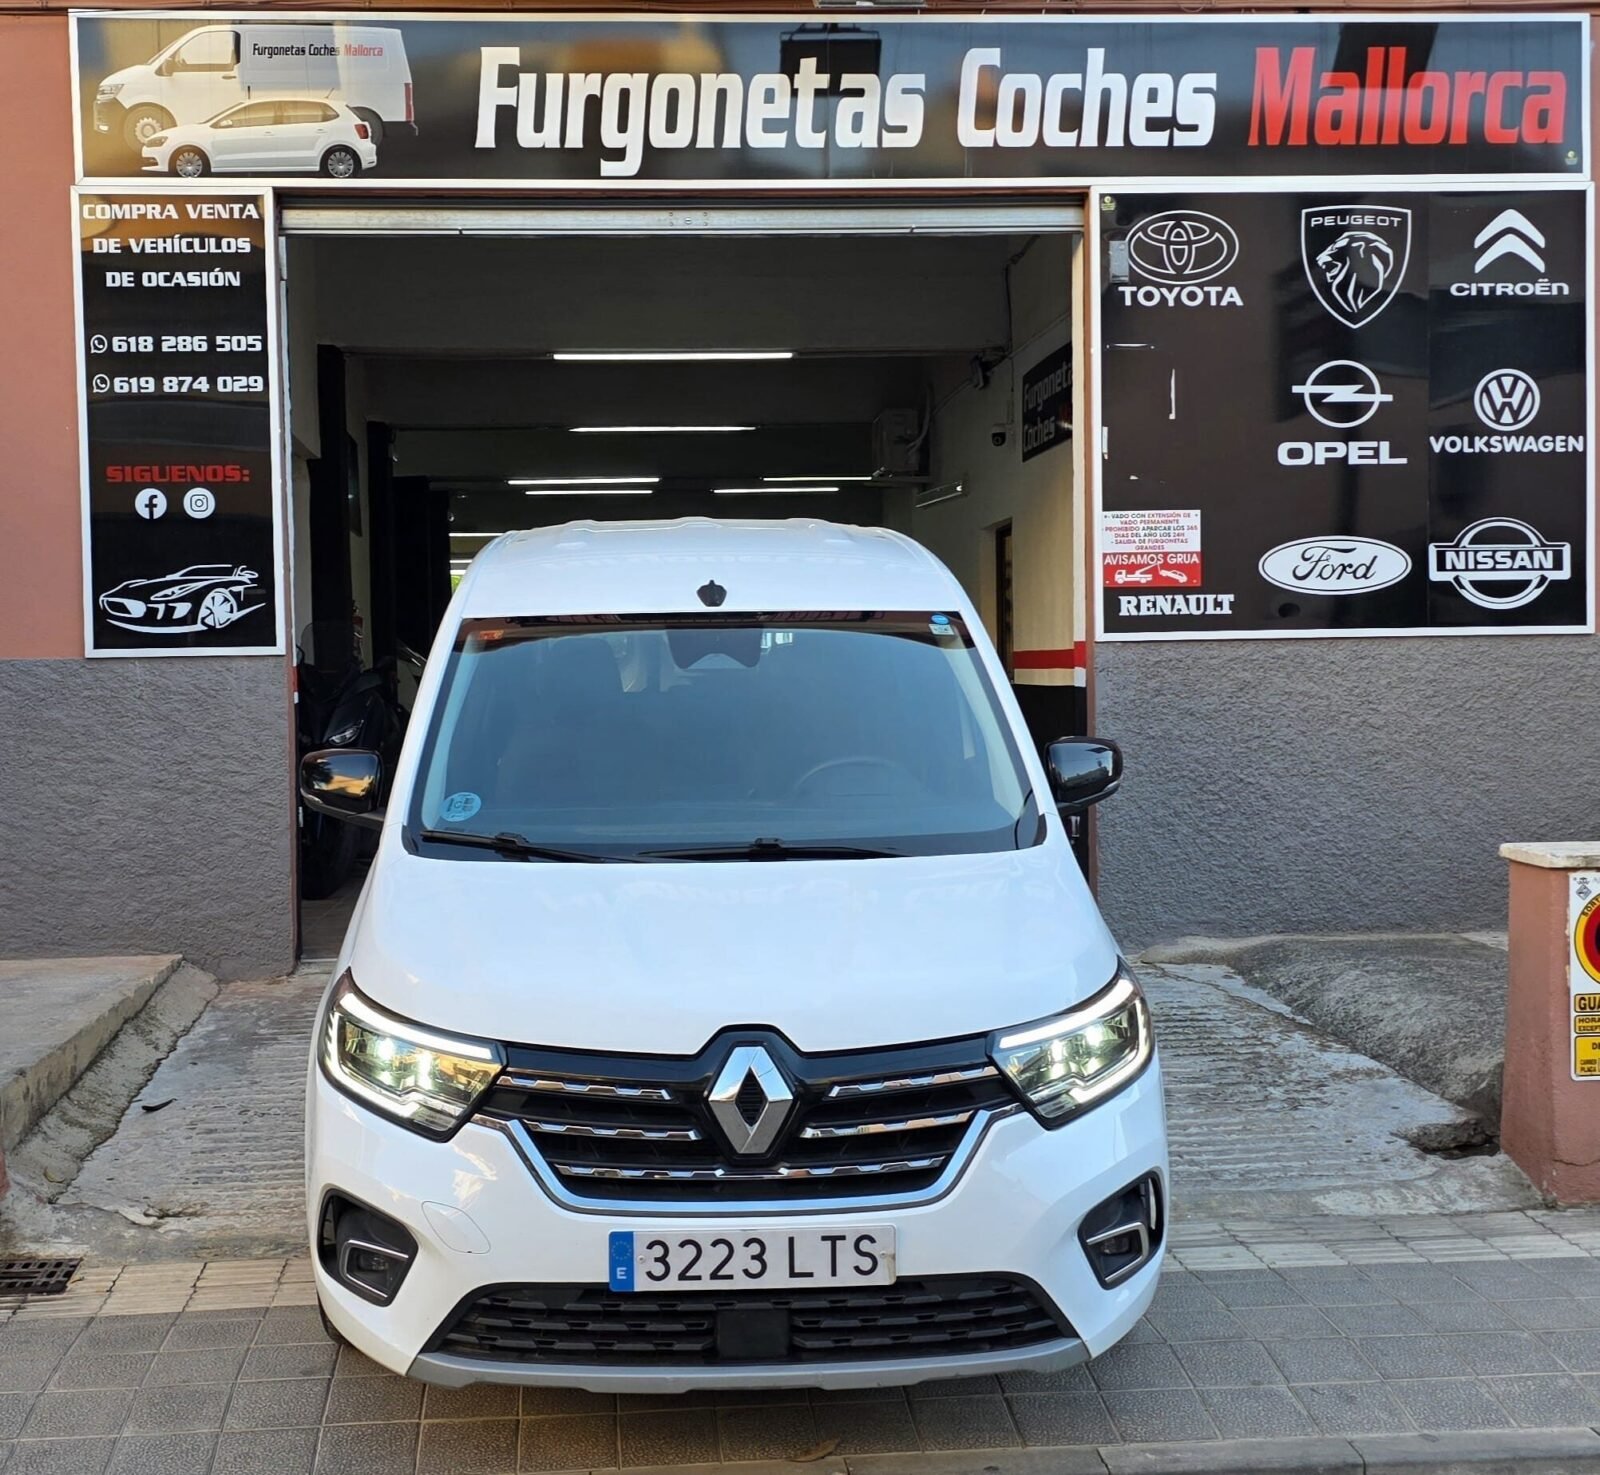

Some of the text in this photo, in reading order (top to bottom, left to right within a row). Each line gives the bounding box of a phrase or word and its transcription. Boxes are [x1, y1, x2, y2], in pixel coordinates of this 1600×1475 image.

[252, 43, 383, 58] Furgonetas Coches Mallorca
[475, 46, 1567, 177] Furgonetas Coches Mallorca
[82, 203, 260, 219] COMPRA VENTA
[1310, 214, 1402, 228] PEUGEOT
[92, 234, 251, 254] DE VEHÍCULOS
[105, 267, 241, 288] DE OCASIÓN
[1118, 286, 1244, 307] TOYOTA
[111, 335, 262, 353] 618 286 505
[113, 375, 264, 393] 619 874 029
[1024, 416, 1055, 452] Coches
[1277, 440, 1408, 466] OPEL
[1429, 435, 1584, 454] VOLKSWAGEN
[105, 464, 250, 483] SIGUENOS:
[1104, 553, 1200, 565] AVISAMOS GRUA
[1292, 545, 1379, 581] Ford
[1445, 550, 1554, 570] NISSAN
[1118, 594, 1235, 616] RENAULT
[645, 1234, 879, 1282] 3223 LTS
[616, 1267, 627, 1279] E
